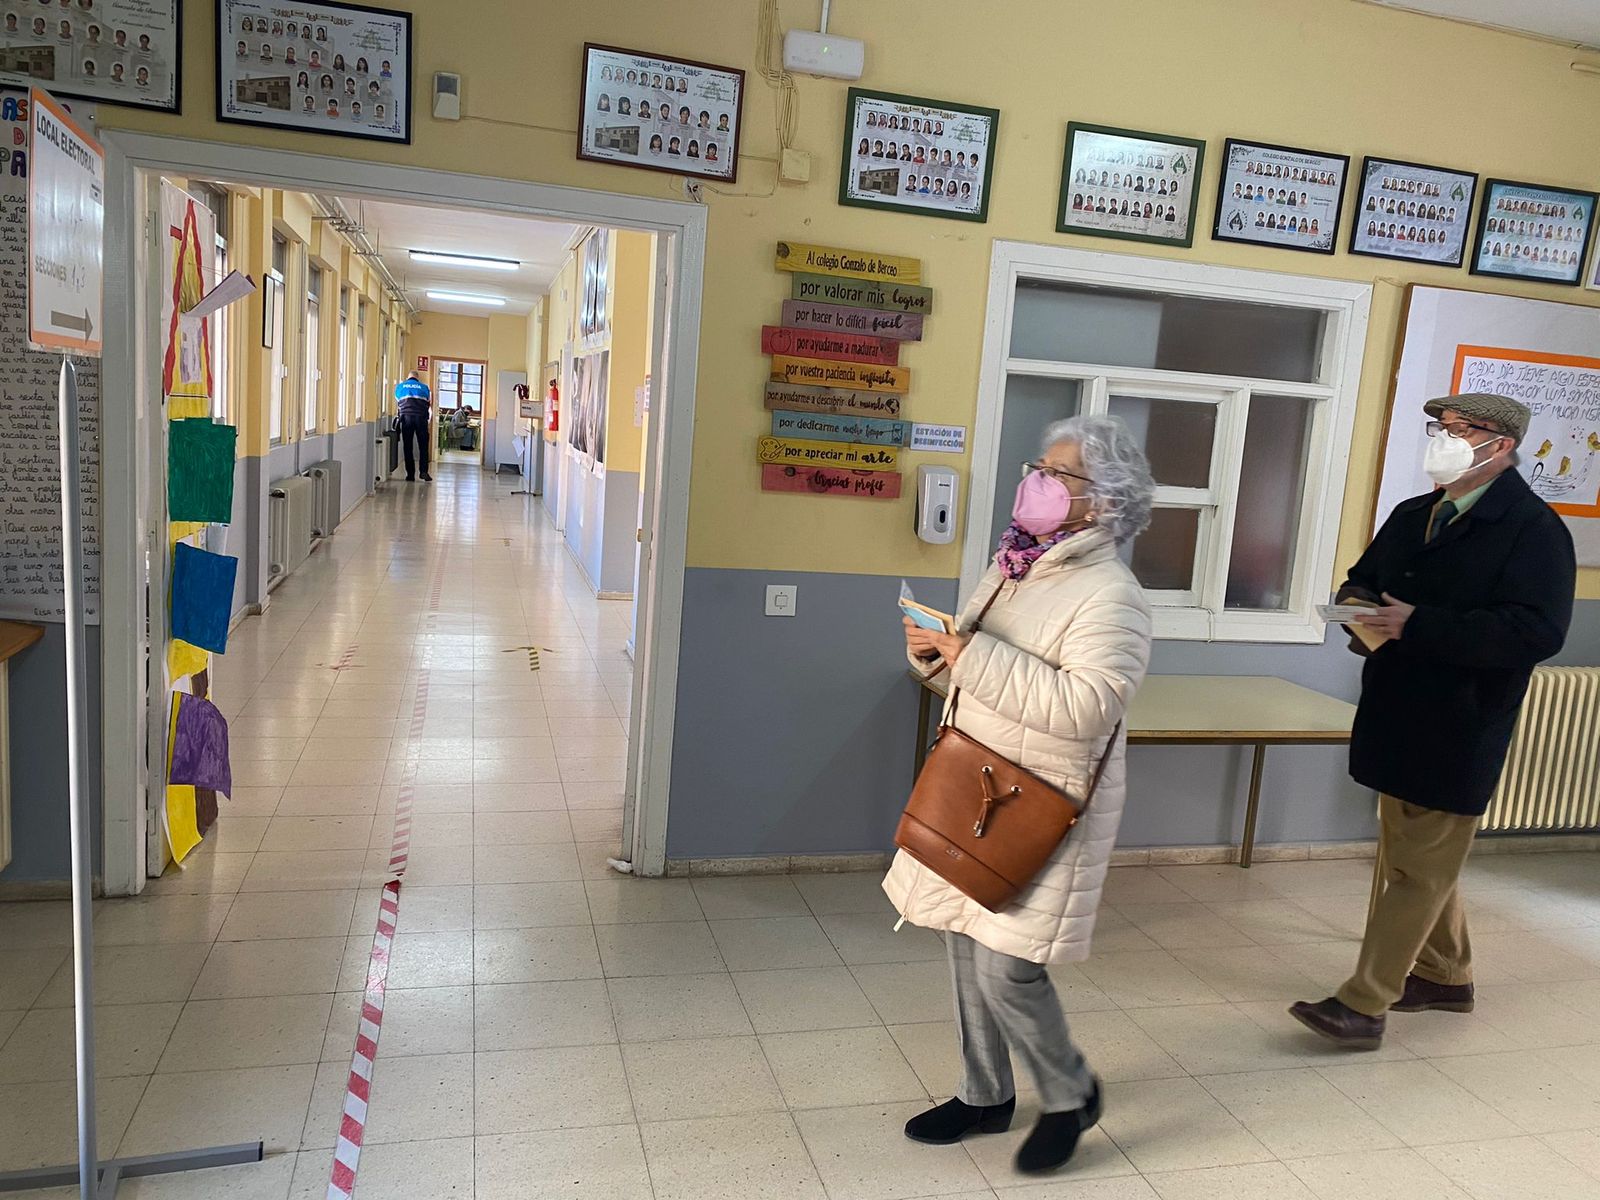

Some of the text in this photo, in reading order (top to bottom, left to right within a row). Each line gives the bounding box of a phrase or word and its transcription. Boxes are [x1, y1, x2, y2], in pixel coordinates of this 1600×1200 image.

[0, 98, 28, 122] AS
[36, 111, 95, 175] LOCAL ELECTORAL
[35, 255, 66, 282] SECCIONES
[806, 251, 897, 277] Al colegio Gonzalo de Berceo
[800, 280, 820, 297] por
[824, 284, 863, 302] valorar
[867, 288, 885, 305] mis
[795, 309, 809, 324] por
[812, 309, 832, 324] hacer
[836, 312, 844, 326] lo
[797, 336, 879, 357] por ayudarme a madurar
[786, 363, 799, 376] por
[800, 365, 823, 378] vuestra
[826, 367, 855, 381] paciencia
[767, 390, 777, 400] por
[780, 391, 810, 406] ayudarme
[779, 418, 794, 429] por
[797, 419, 839, 433] dedicarme
[915, 428, 951, 437] ESTACIÓN
[914, 437, 964, 448] DESINFECCIÓN
[785, 446, 893, 464] por apreciar mi arte
[814, 471, 885, 495] Gracias profes
